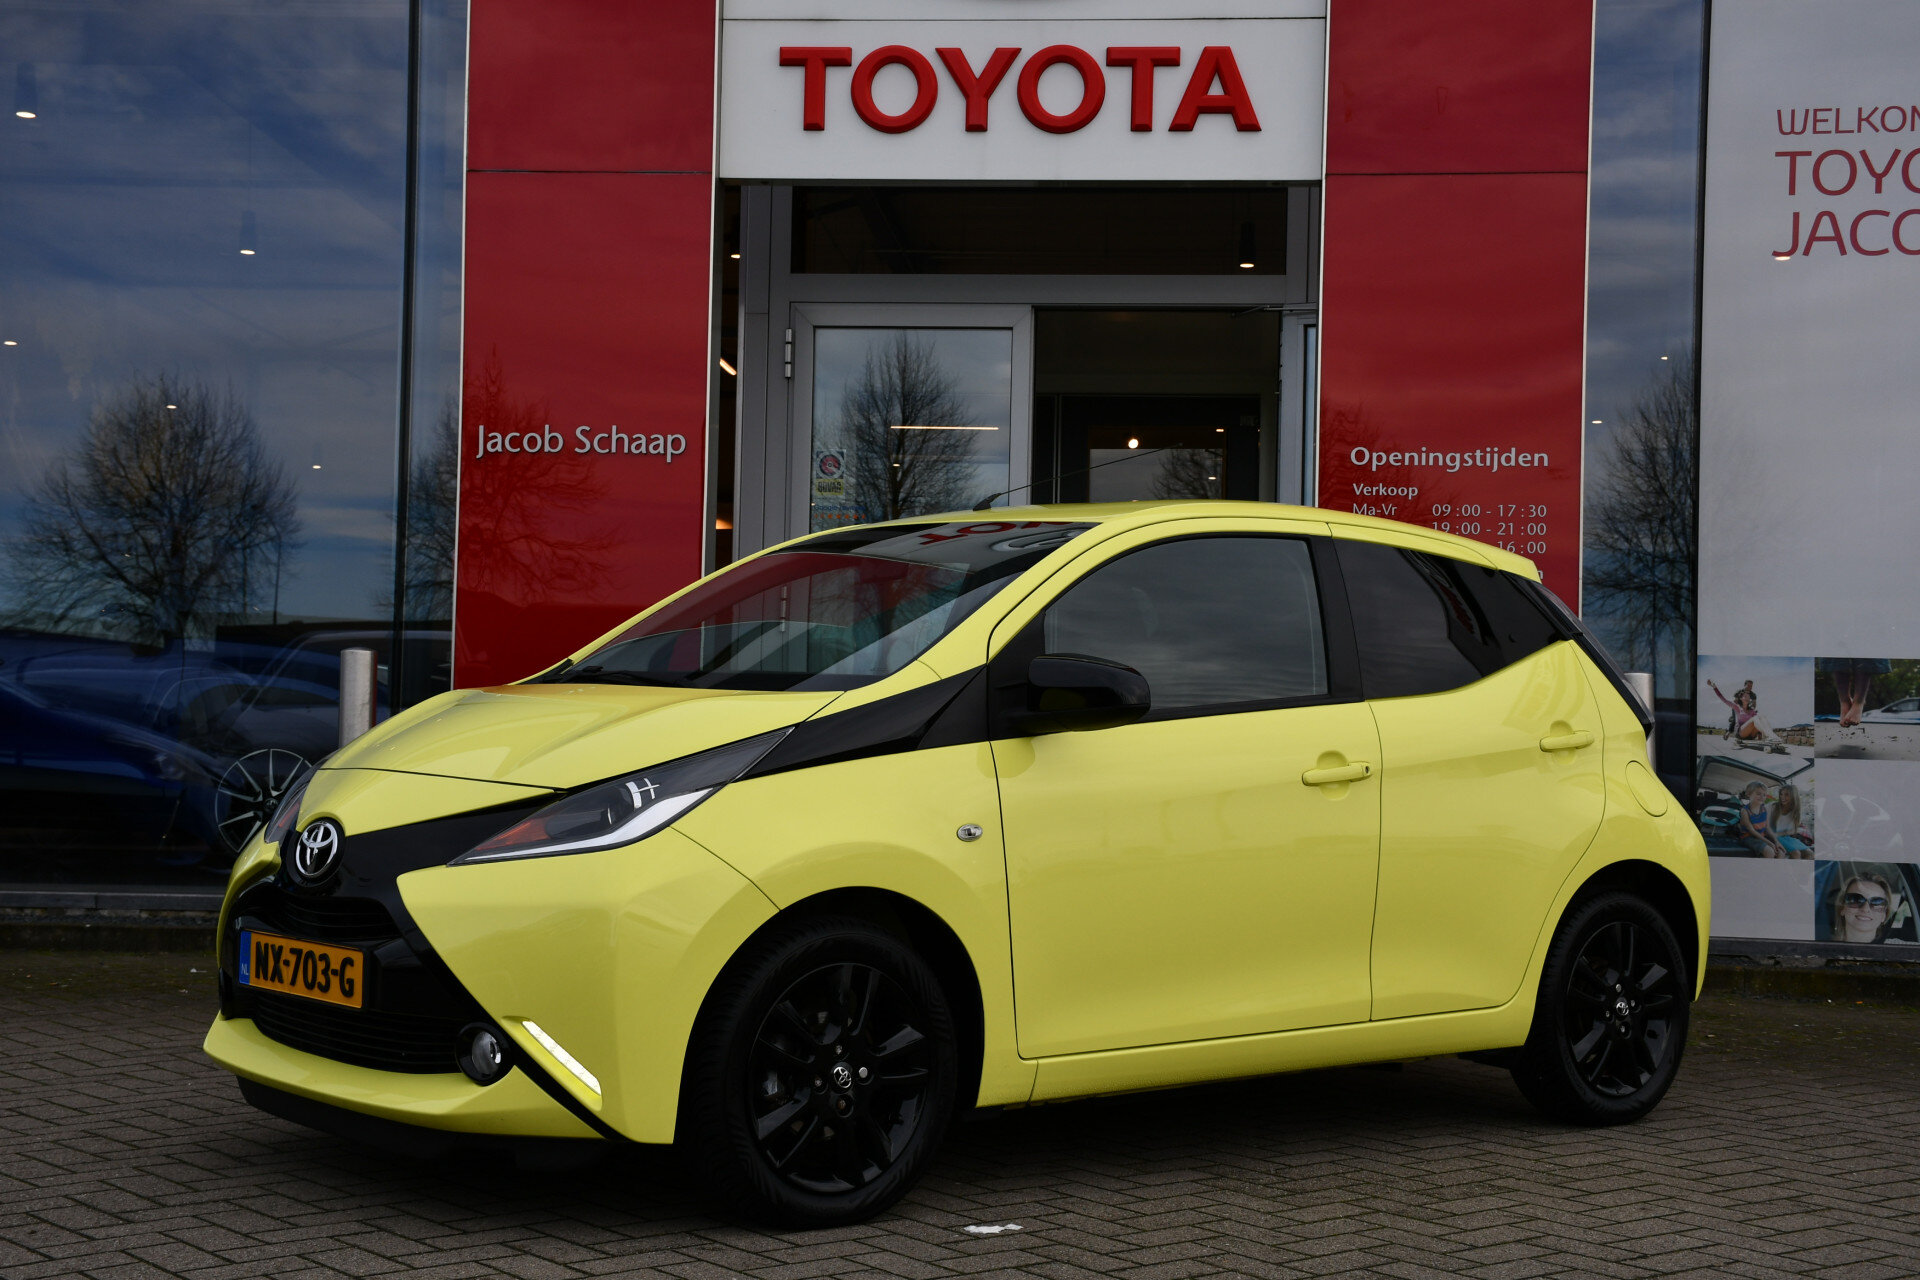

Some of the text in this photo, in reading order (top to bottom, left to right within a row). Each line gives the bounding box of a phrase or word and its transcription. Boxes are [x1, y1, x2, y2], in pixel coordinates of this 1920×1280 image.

[779, 44, 1262, 134] TOYOTA
[1771, 208, 1920, 256] JACO
[476, 424, 686, 463] Jacob Schaap
[1350, 446, 1549, 473] Openingstijden
[1352, 483, 1419, 500] Verkoop
[1352, 503, 1398, 516] Ma-Vr
[241, 963, 249, 976] NL
[255, 941, 355, 998] NX-703-G
